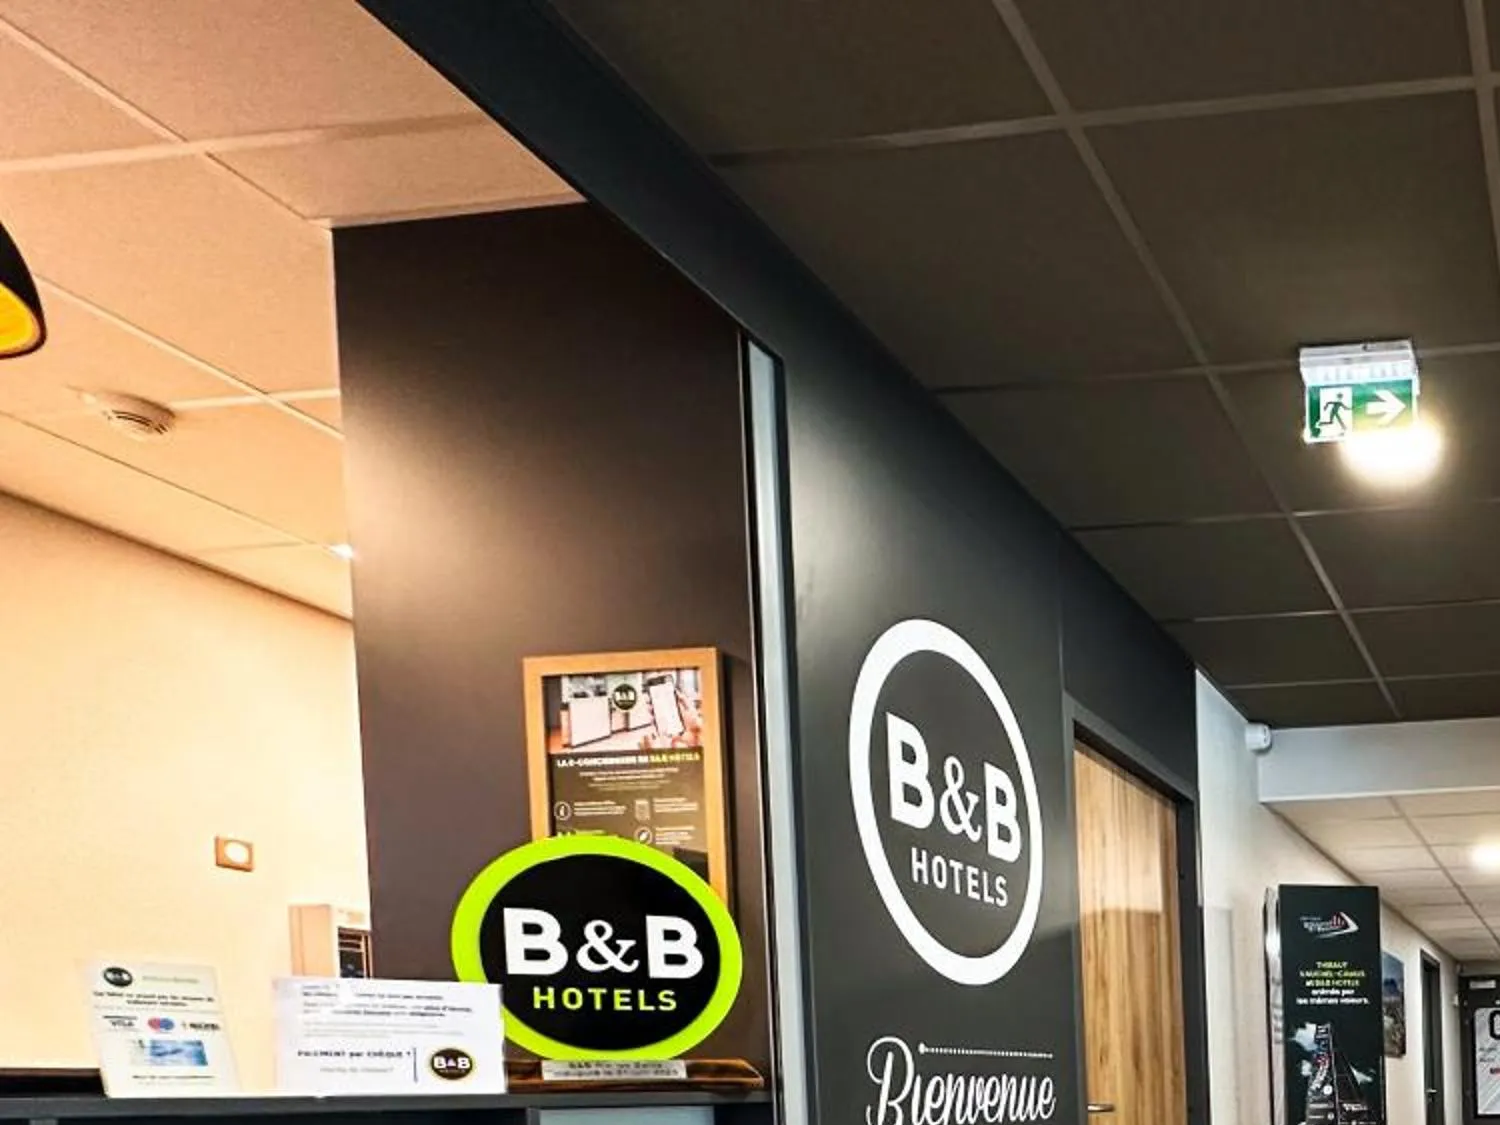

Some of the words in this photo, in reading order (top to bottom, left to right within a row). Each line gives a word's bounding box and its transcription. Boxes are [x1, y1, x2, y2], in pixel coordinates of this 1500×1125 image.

[885, 711, 1022, 863] B&B
[911, 847, 1008, 907] HOTELS
[503, 907, 705, 979] B&B
[533, 986, 678, 1011] HOTELS
[433, 1056, 471, 1069] B&B
